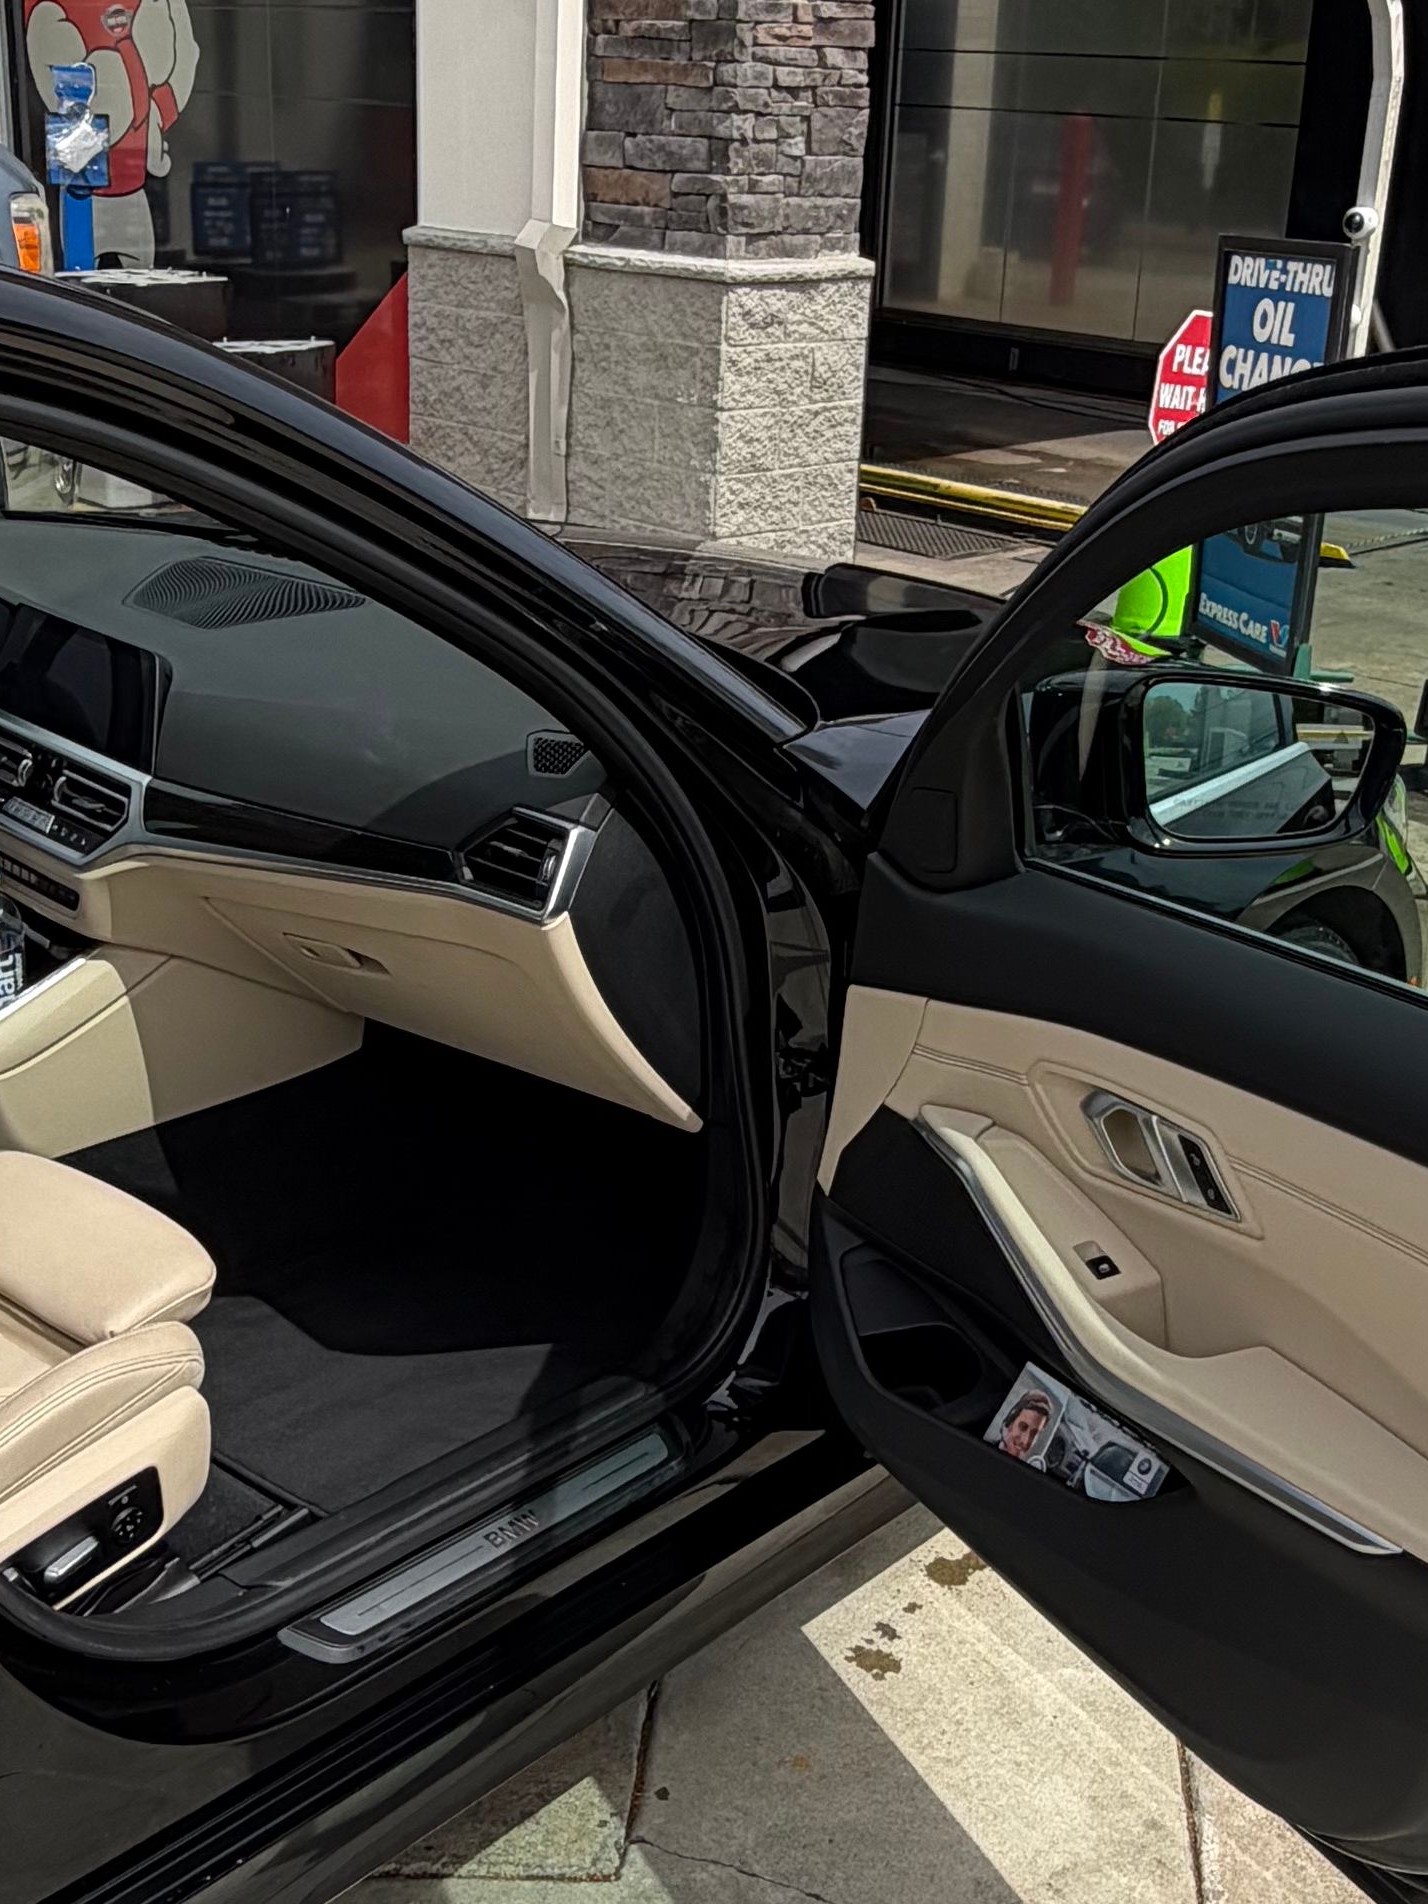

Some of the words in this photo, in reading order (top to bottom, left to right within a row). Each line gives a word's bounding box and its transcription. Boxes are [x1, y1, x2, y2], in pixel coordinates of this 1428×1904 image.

[1228, 255, 1335, 297] DRIVE-THRU
[1252, 298, 1295, 347] OIL
[1219, 345, 1324, 391] CHAN
[1159, 383, 1196, 411] WAIT
[483, 1509, 539, 1549] BMW
